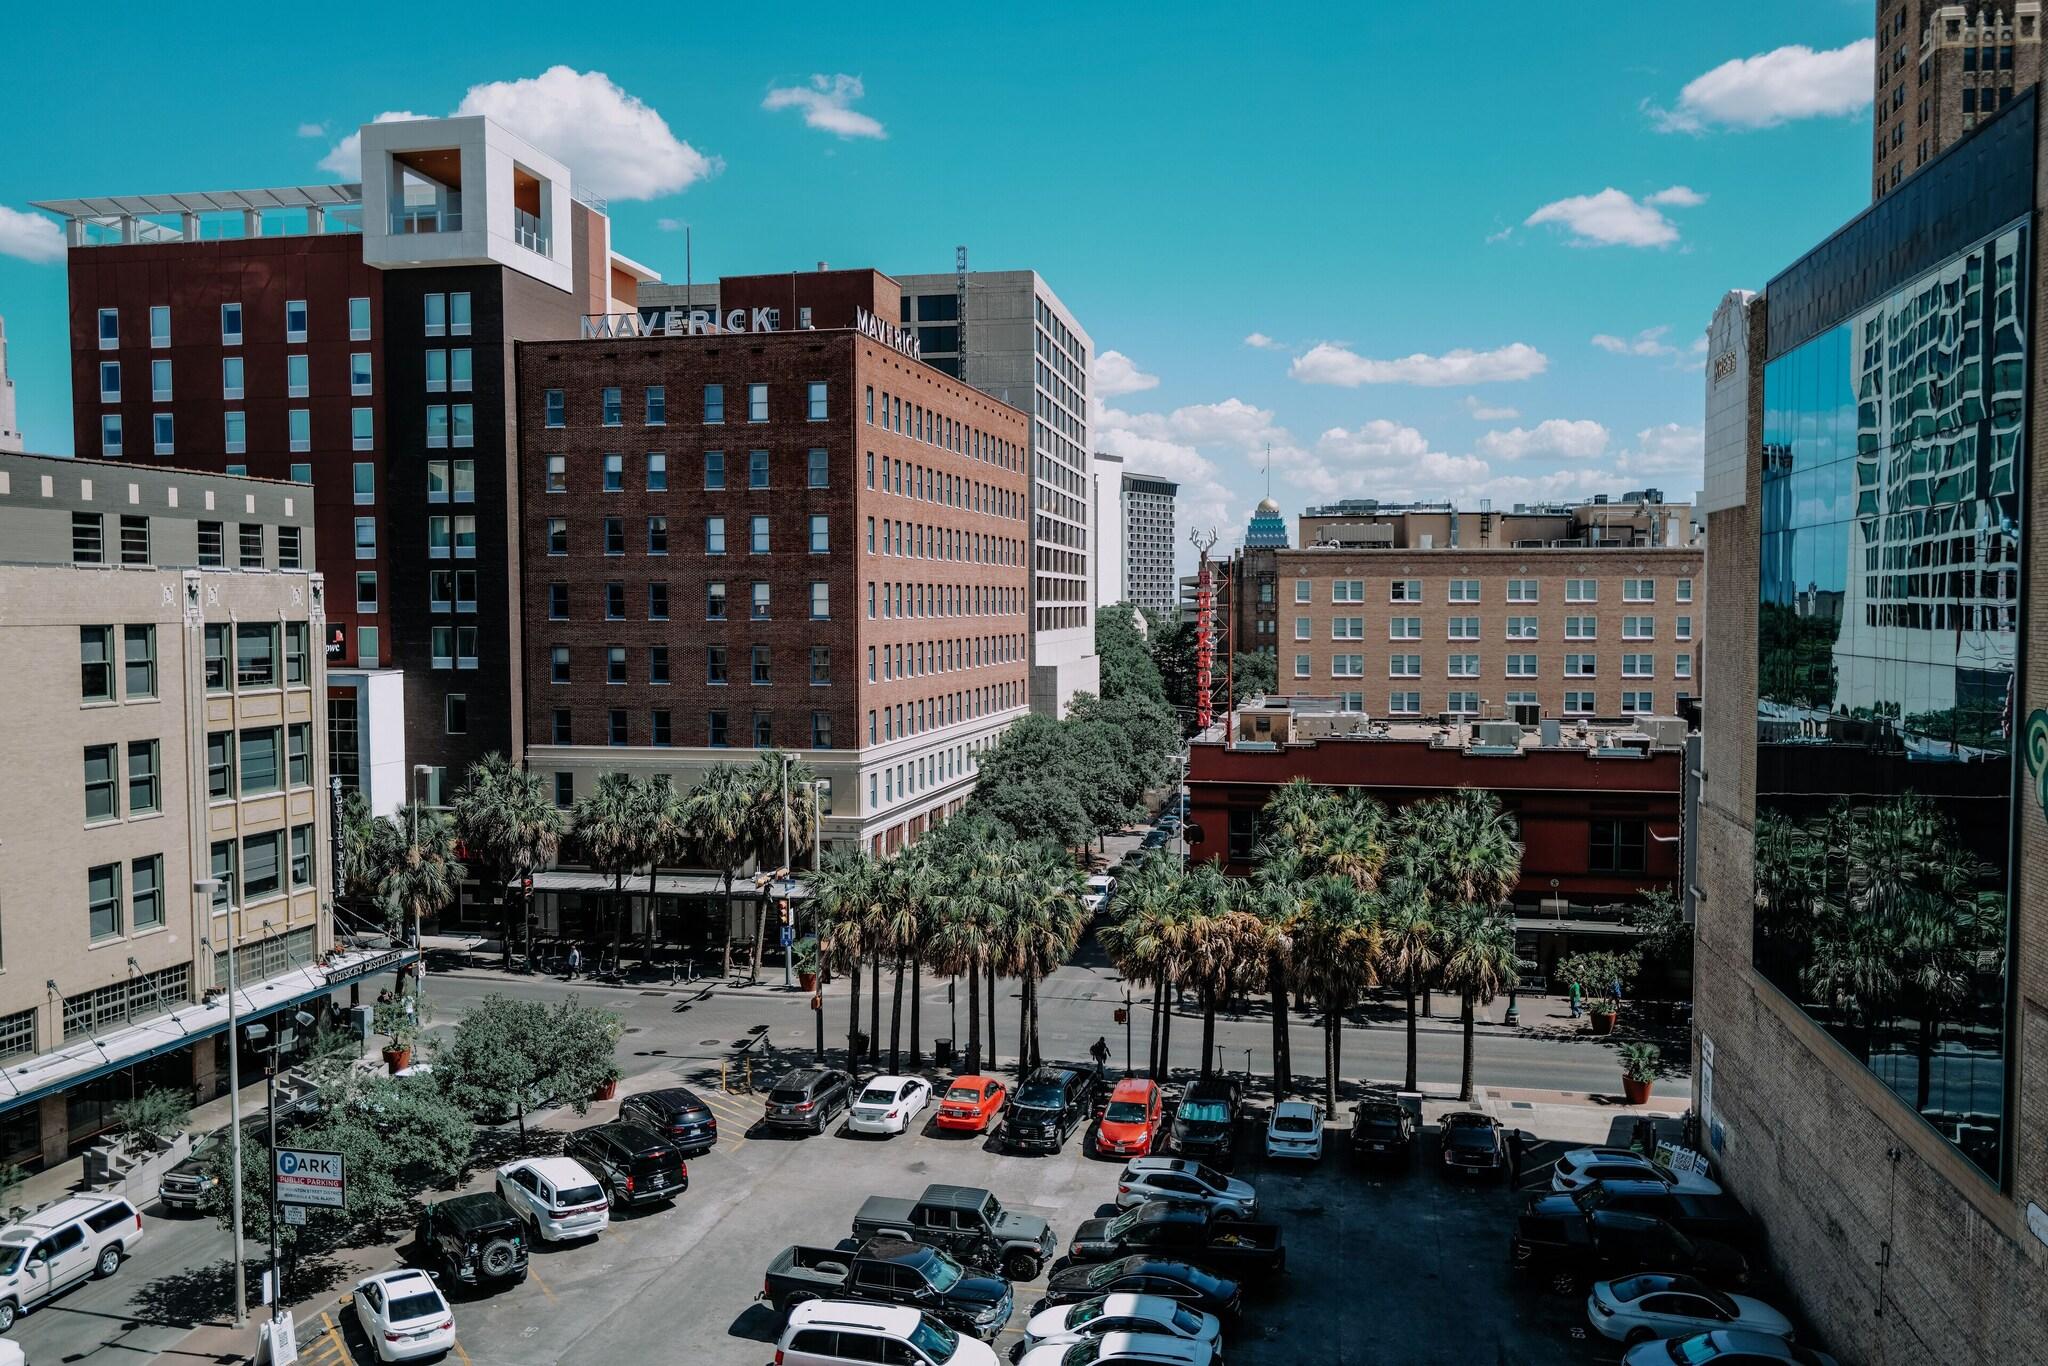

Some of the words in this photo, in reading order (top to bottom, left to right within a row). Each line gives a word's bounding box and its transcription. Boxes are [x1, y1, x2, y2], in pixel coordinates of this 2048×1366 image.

[580, 306, 775, 339] MAVERICK
[856, 305, 921, 360] MAVERICK
[328, 964, 364, 984] WHISKEY
[364, 951, 403, 972] DISTILLERY
[281, 1154, 331, 1174] PARK
[279, 1176, 305, 1185] PUBLIC
[307, 1178, 339, 1187] PARKING
